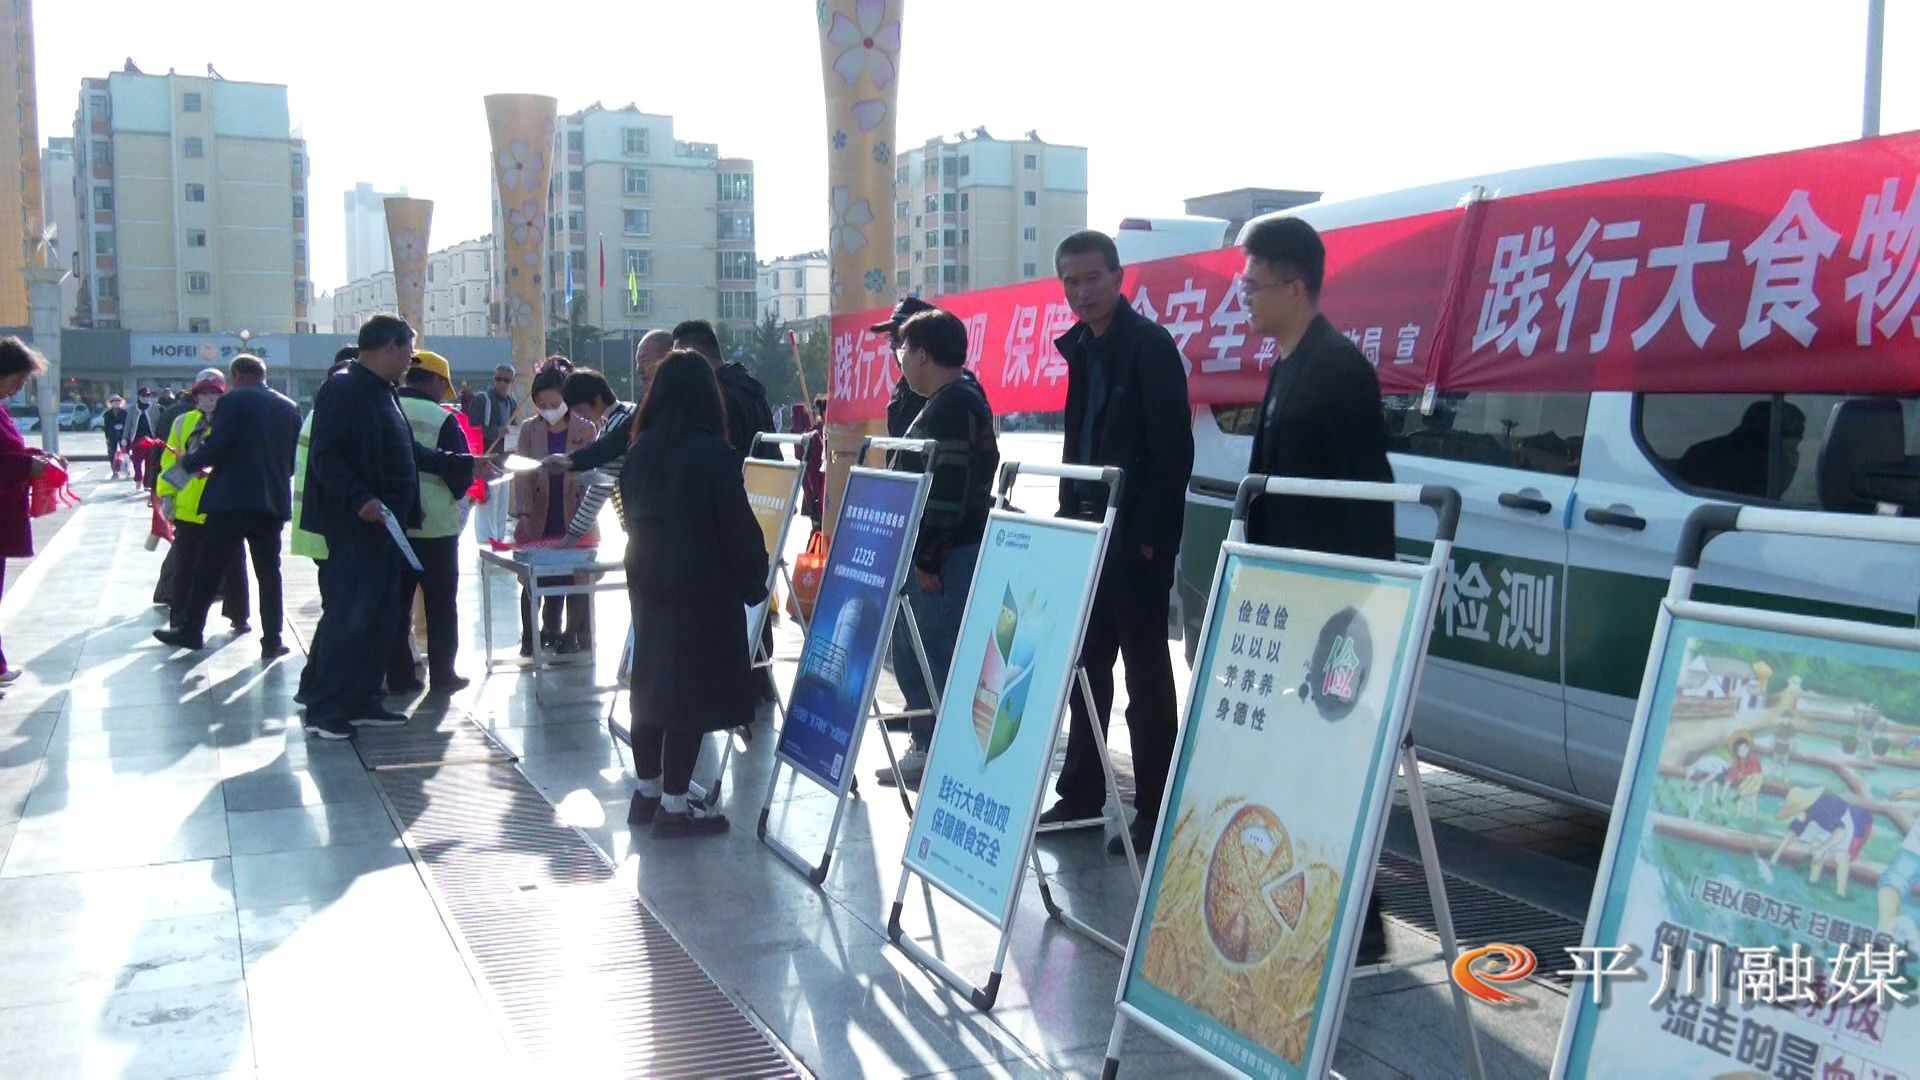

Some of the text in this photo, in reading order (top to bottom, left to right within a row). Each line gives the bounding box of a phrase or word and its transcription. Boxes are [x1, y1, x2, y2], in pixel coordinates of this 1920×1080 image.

[1472, 176, 1920, 358] 践行大食物
[151, 345, 197, 357] MOFEI
[1393, 321, 1421, 365] 宣
[851, 546, 876, 568] 12325
[1440, 558, 1554, 657] 检测
[937, 775, 1011, 834] 践行大食物观
[930, 807, 1002, 868] 保障粮食安全
[1702, 880, 1803, 931] 民以食为天
